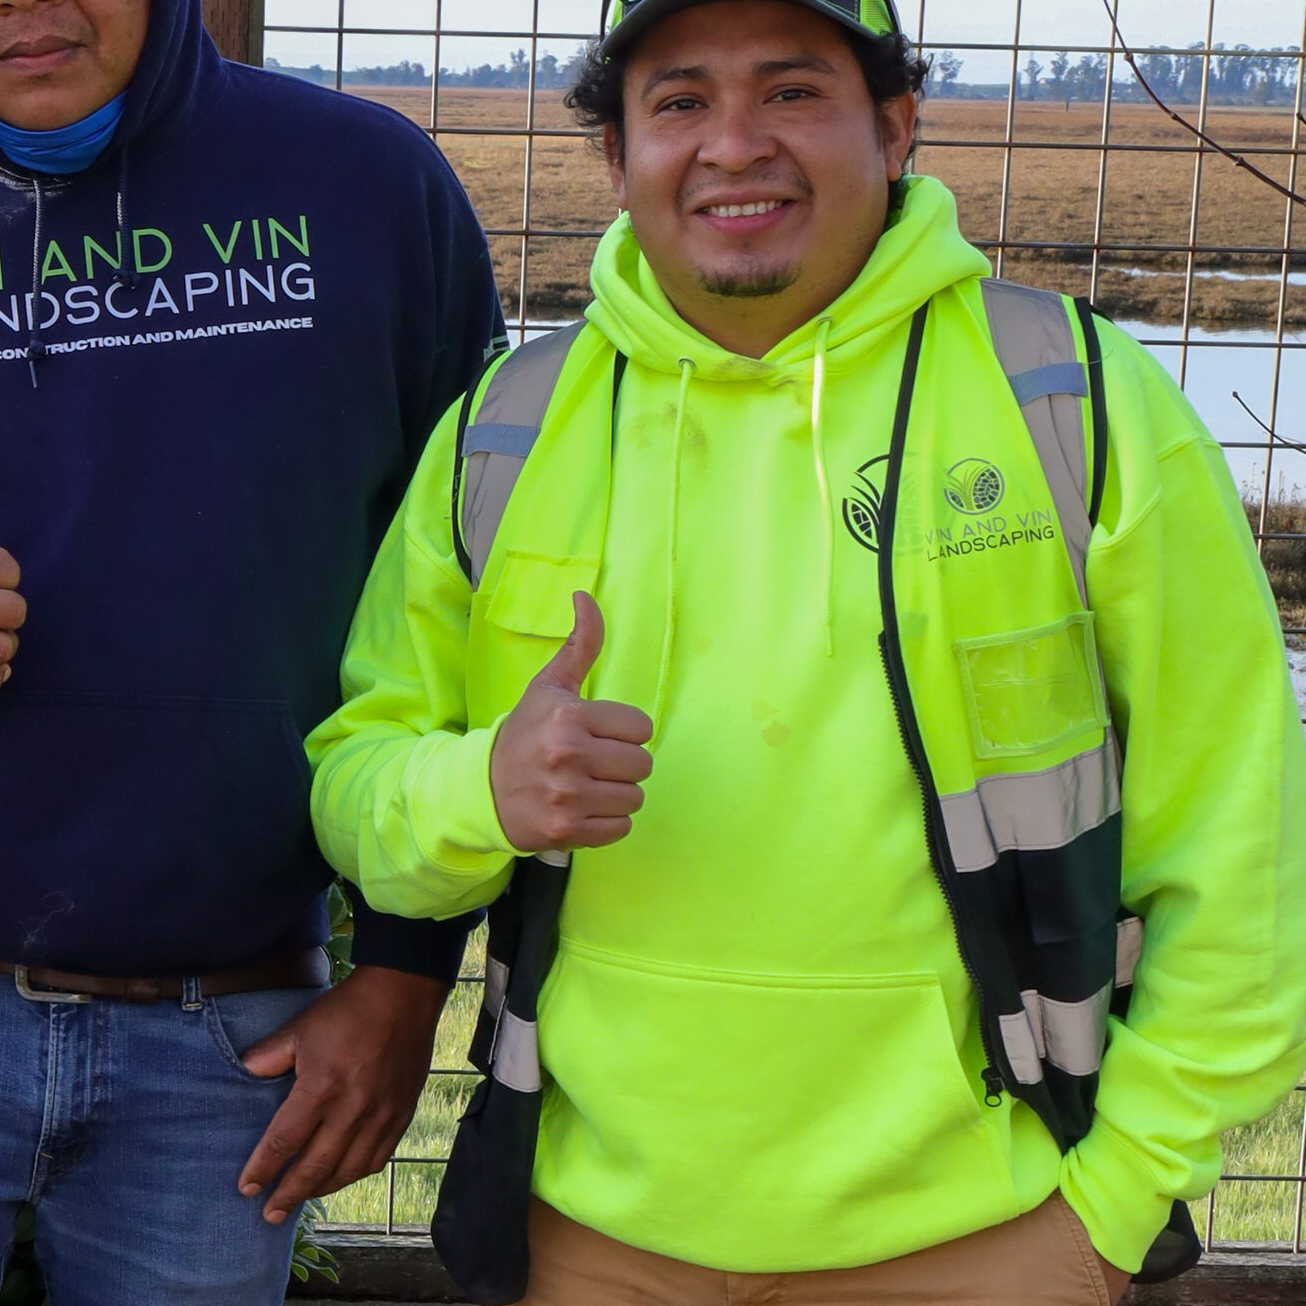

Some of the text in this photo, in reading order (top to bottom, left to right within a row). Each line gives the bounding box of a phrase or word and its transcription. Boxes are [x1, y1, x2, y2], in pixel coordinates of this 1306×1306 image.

[41, 228, 173, 286] AND
[202, 215, 311, 264] VIN
[132, 331, 174, 346] AND
[175, 316, 314, 342] MAINTENANCE
[925, 507, 1052, 545] VIN AND VIN
[927, 525, 1055, 562] LANDSCAPING
